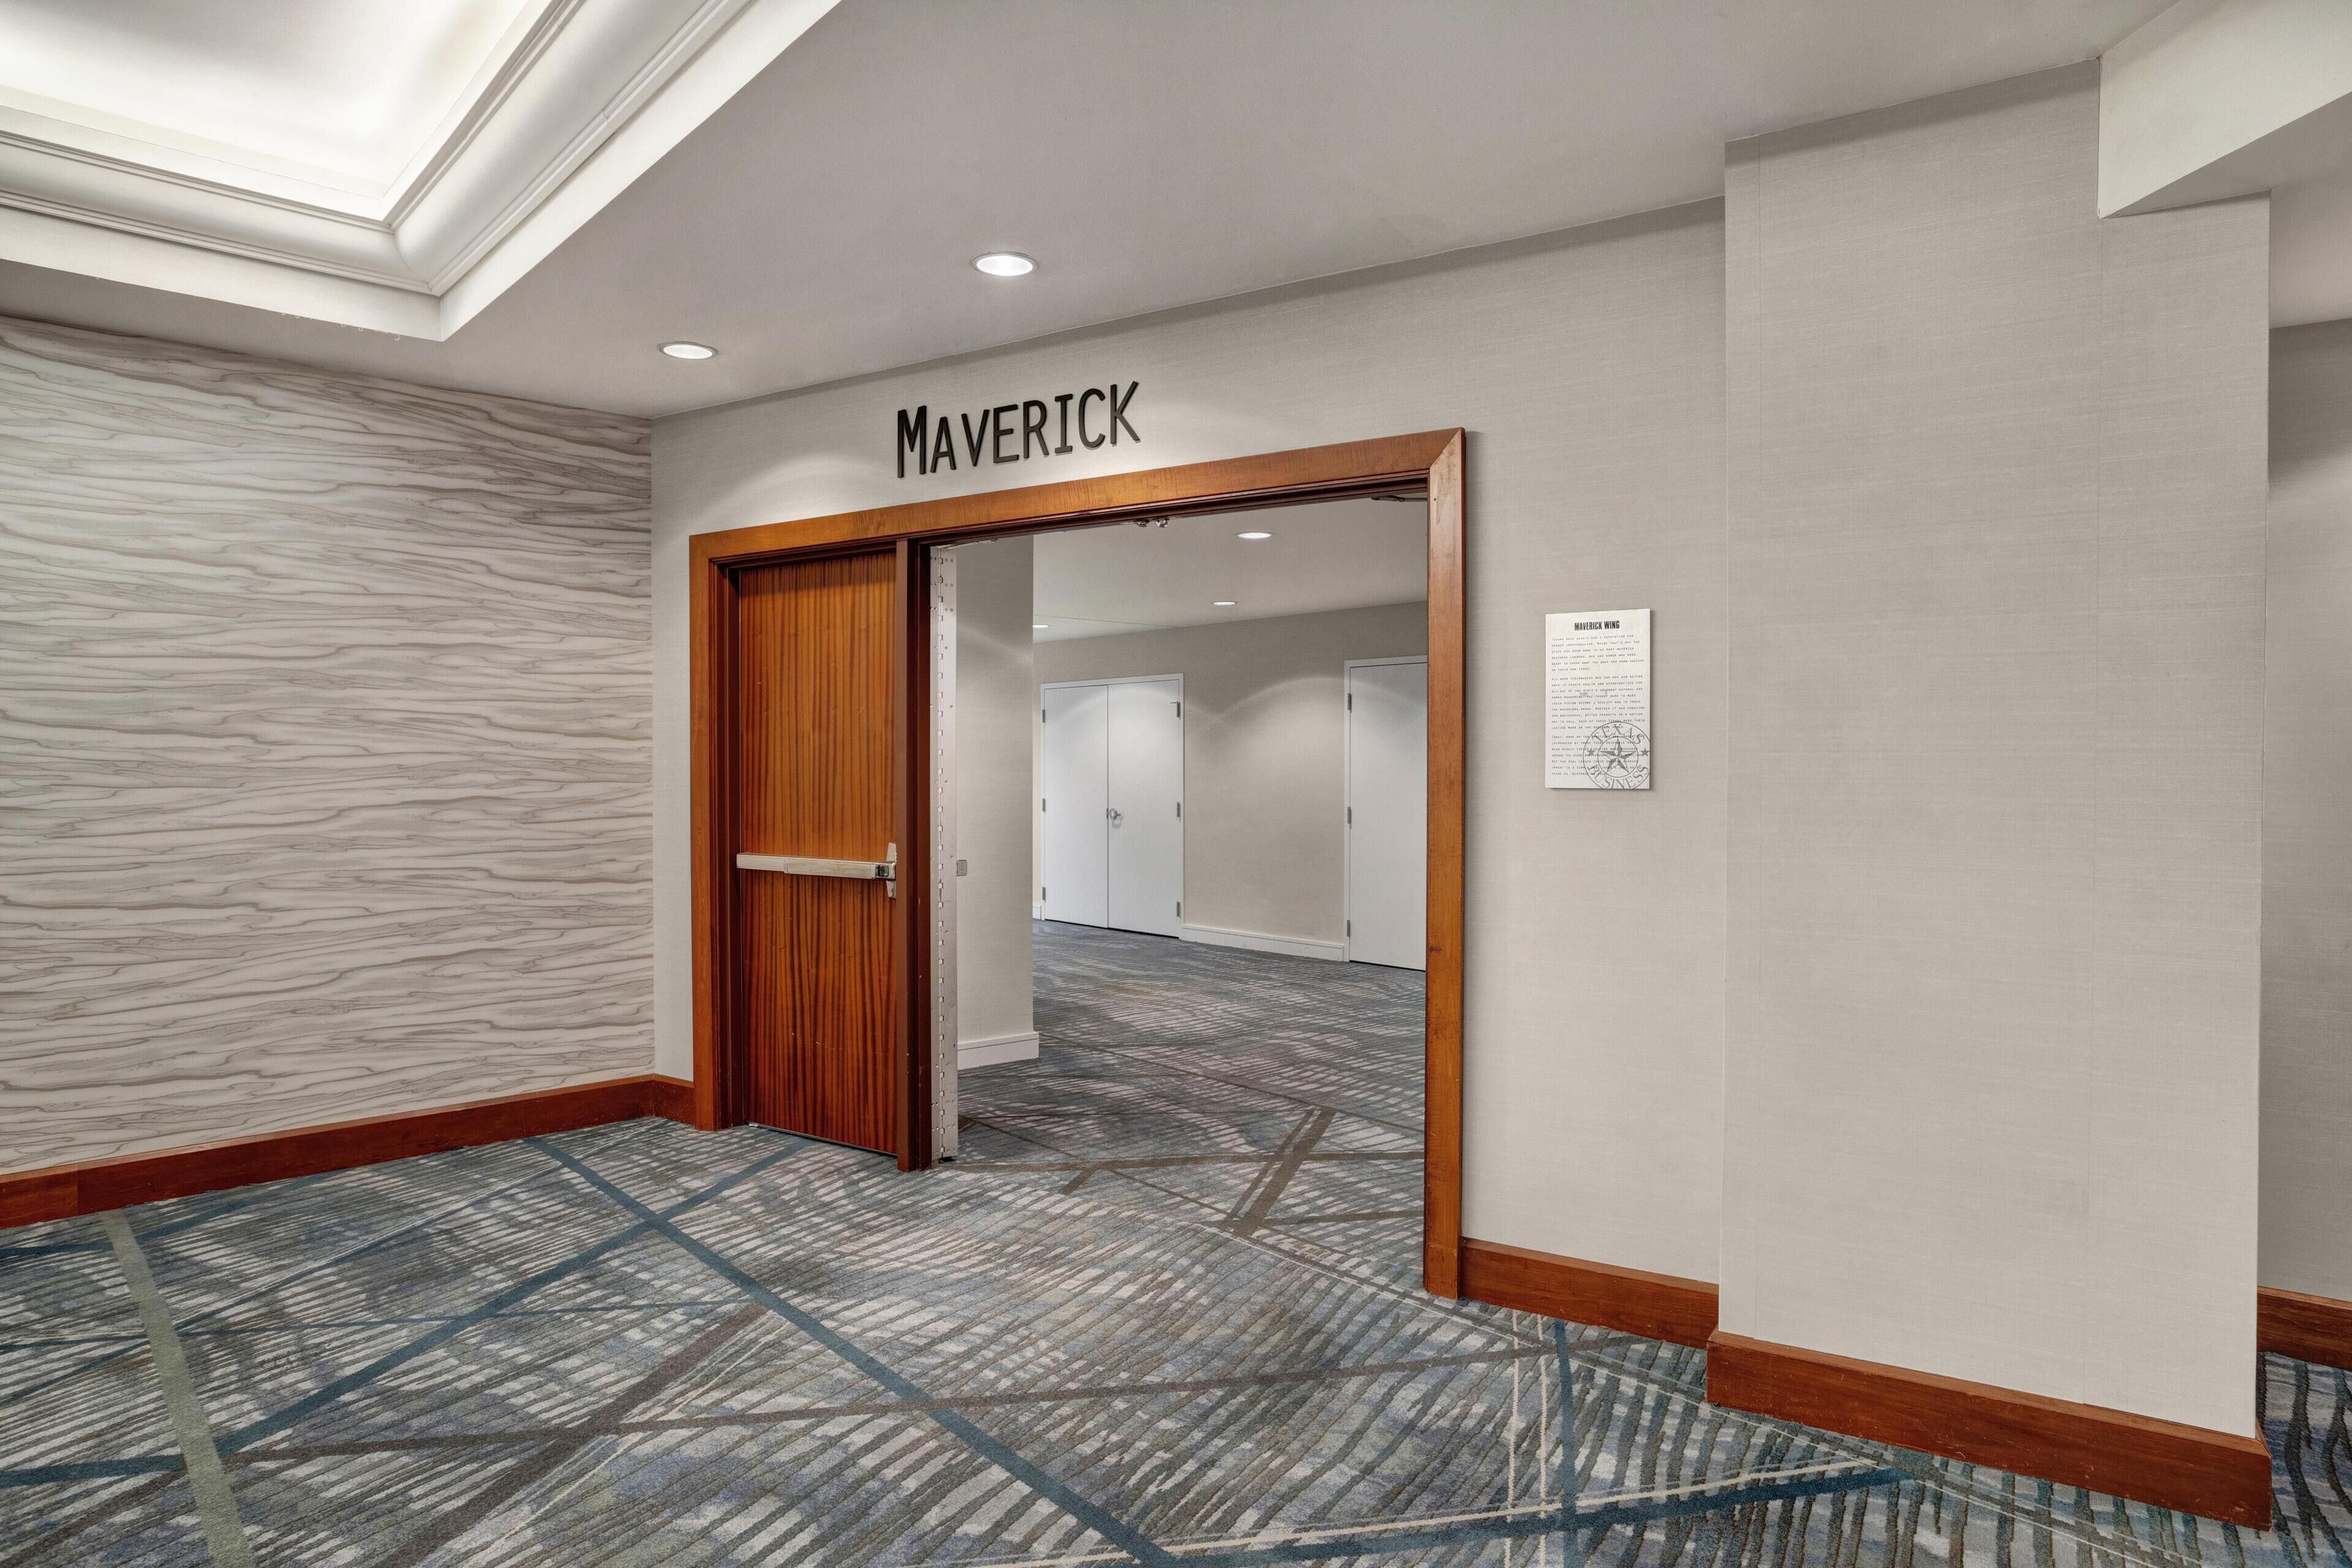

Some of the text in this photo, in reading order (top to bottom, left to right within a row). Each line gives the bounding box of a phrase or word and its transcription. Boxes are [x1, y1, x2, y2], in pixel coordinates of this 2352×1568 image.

[897, 380, 1140, 479] MAVERICK
[1574, 620, 1620, 631] MAVERICK WING
